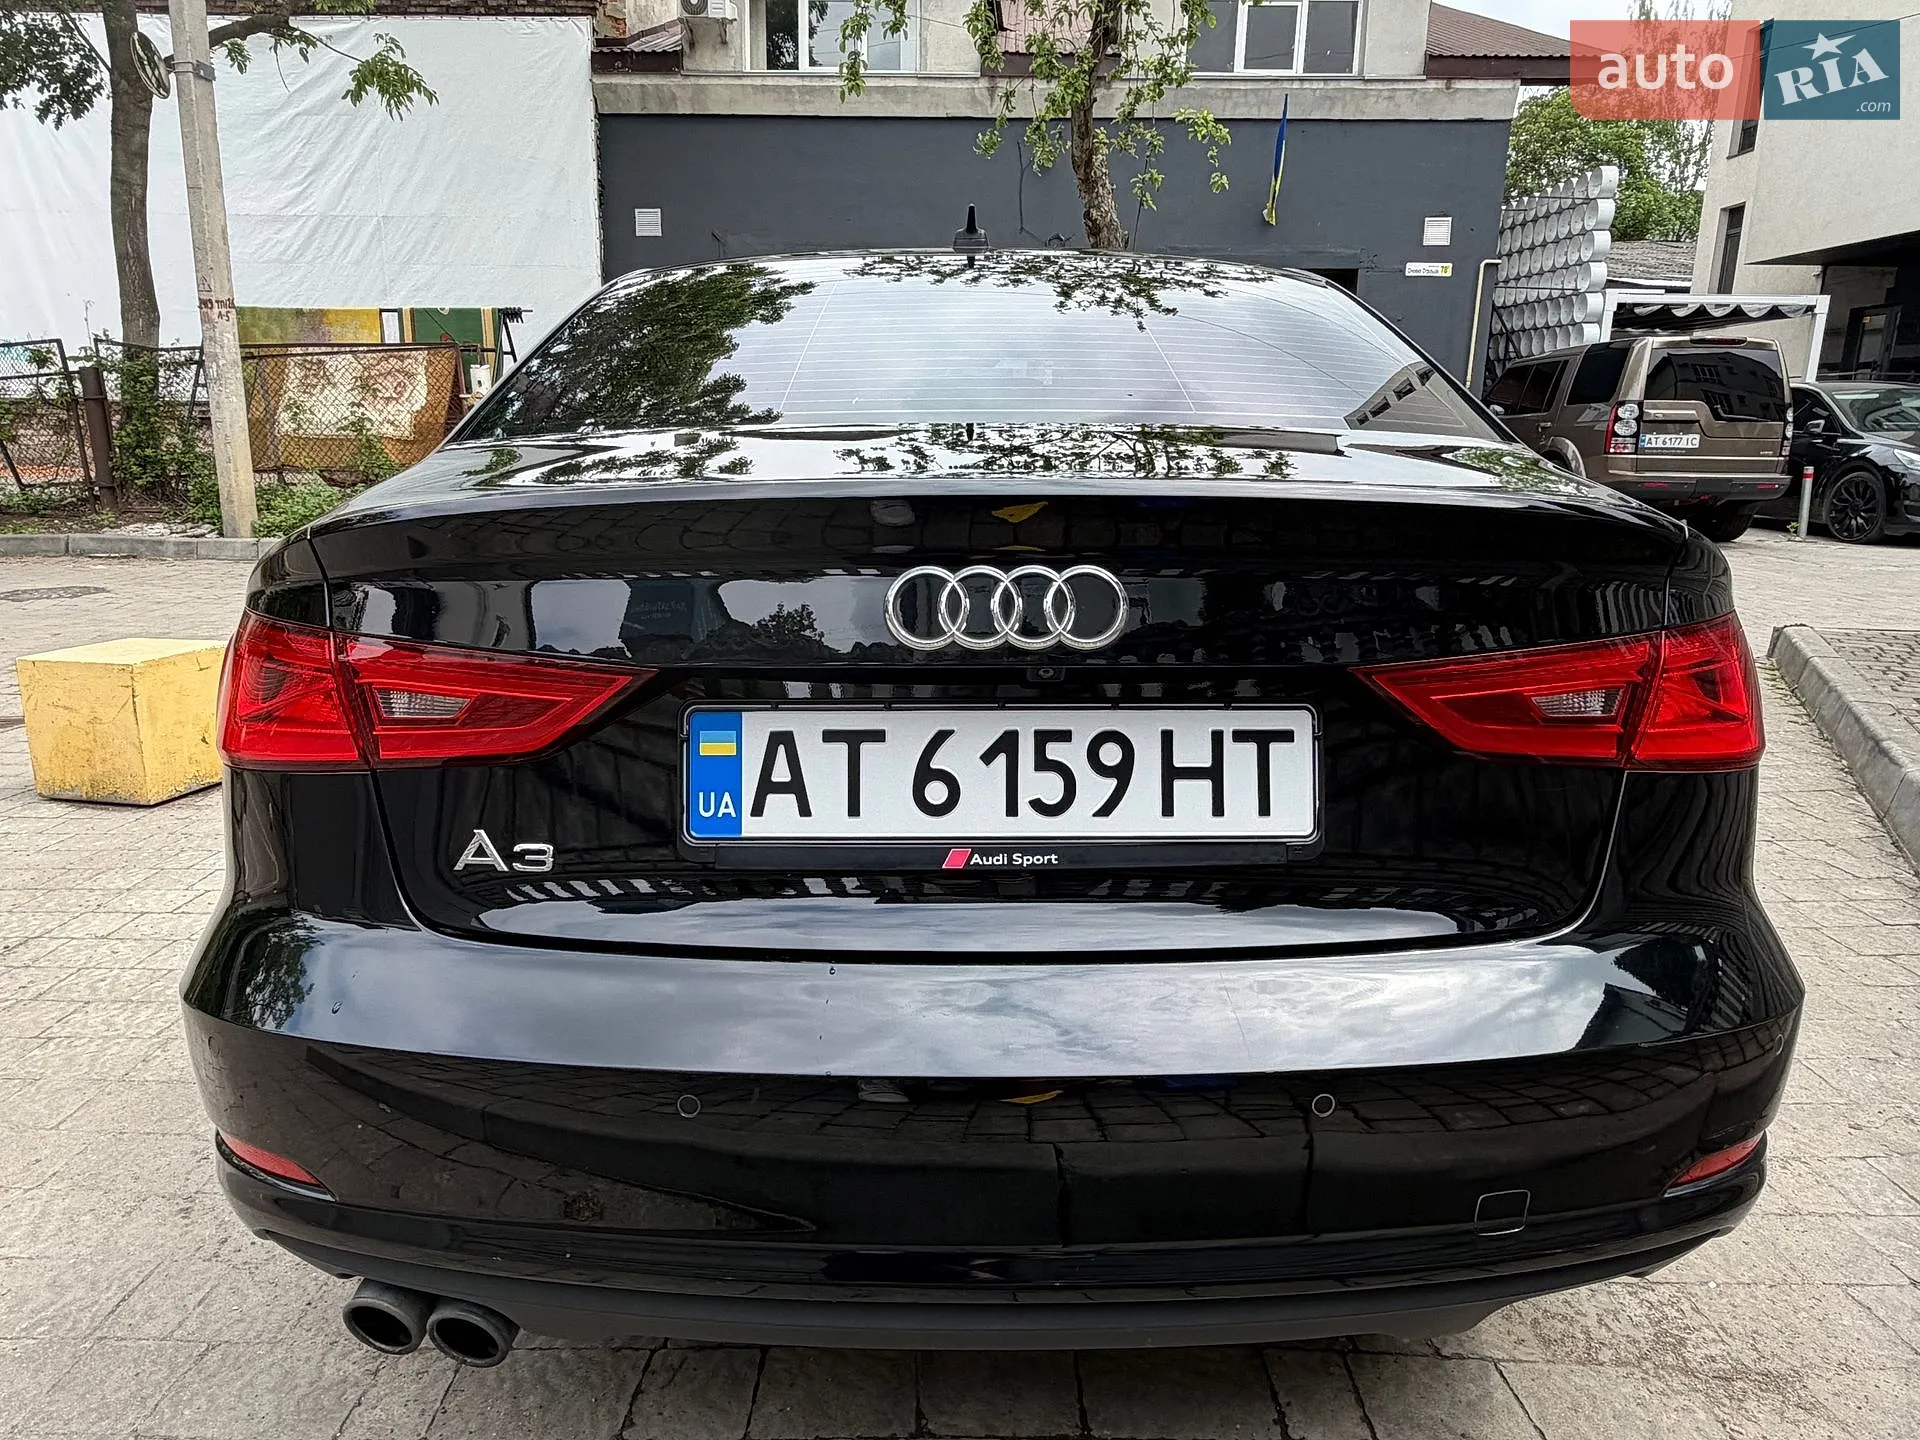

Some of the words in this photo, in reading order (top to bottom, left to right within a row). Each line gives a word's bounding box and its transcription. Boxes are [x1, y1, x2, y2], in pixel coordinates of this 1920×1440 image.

[1662, 437, 1683, 446] 6177
[750, 730, 886, 817] AT
[912, 729, 1135, 817] 6159
[1161, 729, 1295, 817] HT
[698, 792, 737, 818] UA
[453, 829, 554, 872] A3
[970, 853, 1008, 865] Audi
[1012, 853, 1059, 867] Sport
